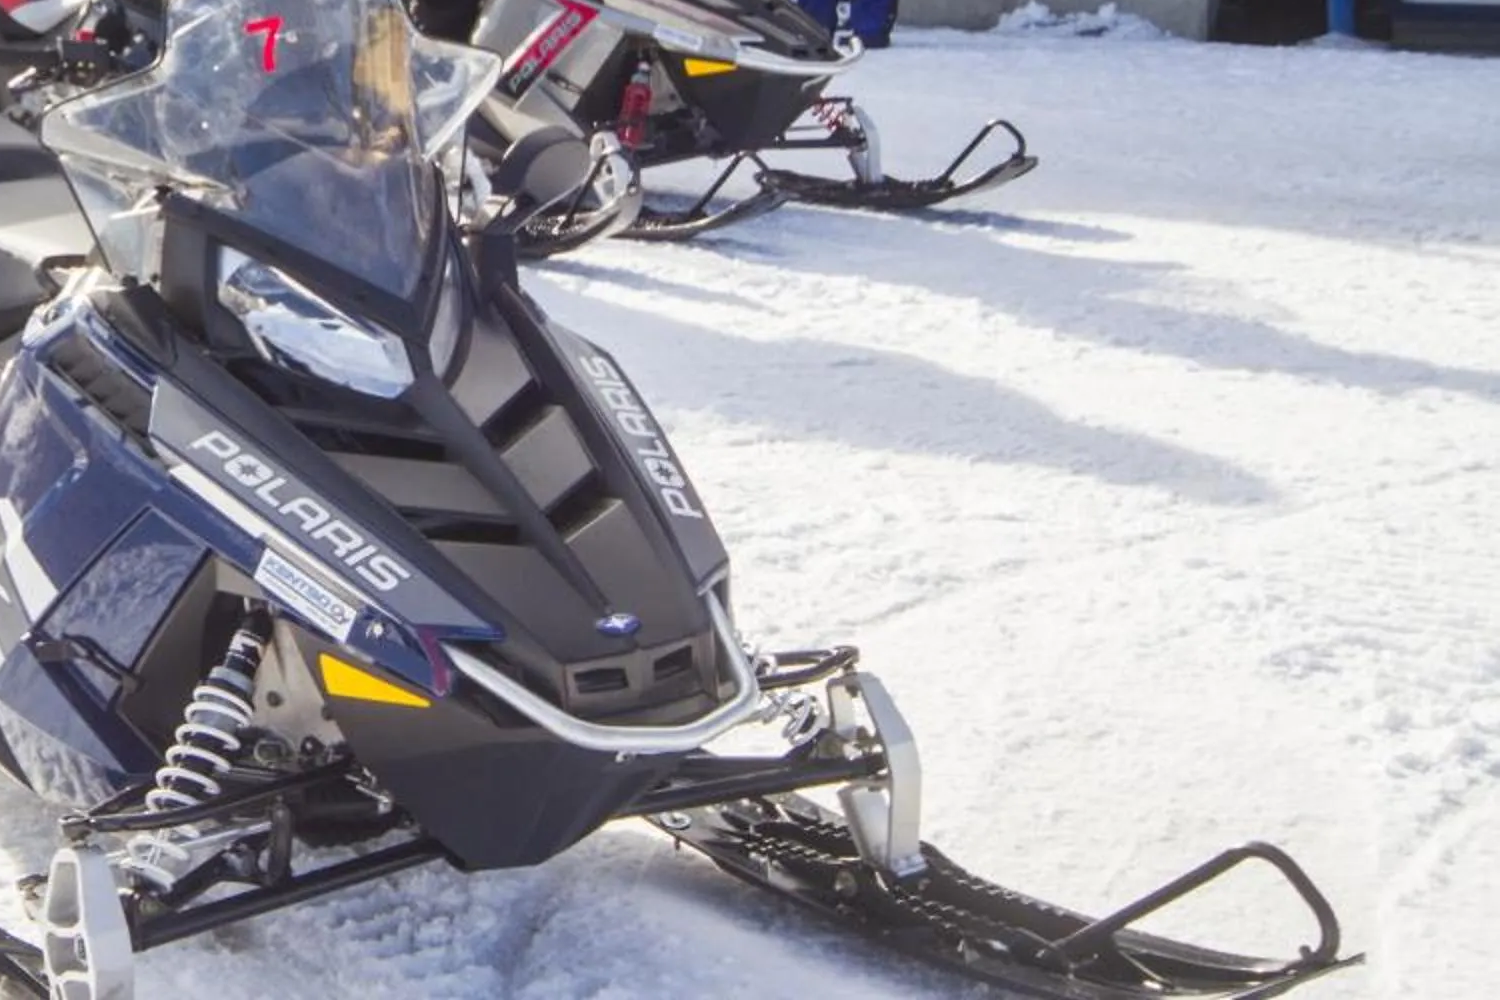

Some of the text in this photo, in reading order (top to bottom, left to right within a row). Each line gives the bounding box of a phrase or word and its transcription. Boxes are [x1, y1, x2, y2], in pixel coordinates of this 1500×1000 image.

[243, 13, 285, 75] 7
[190, 430, 411, 592] POLARIS
[579, 356, 704, 519] POLARIS
